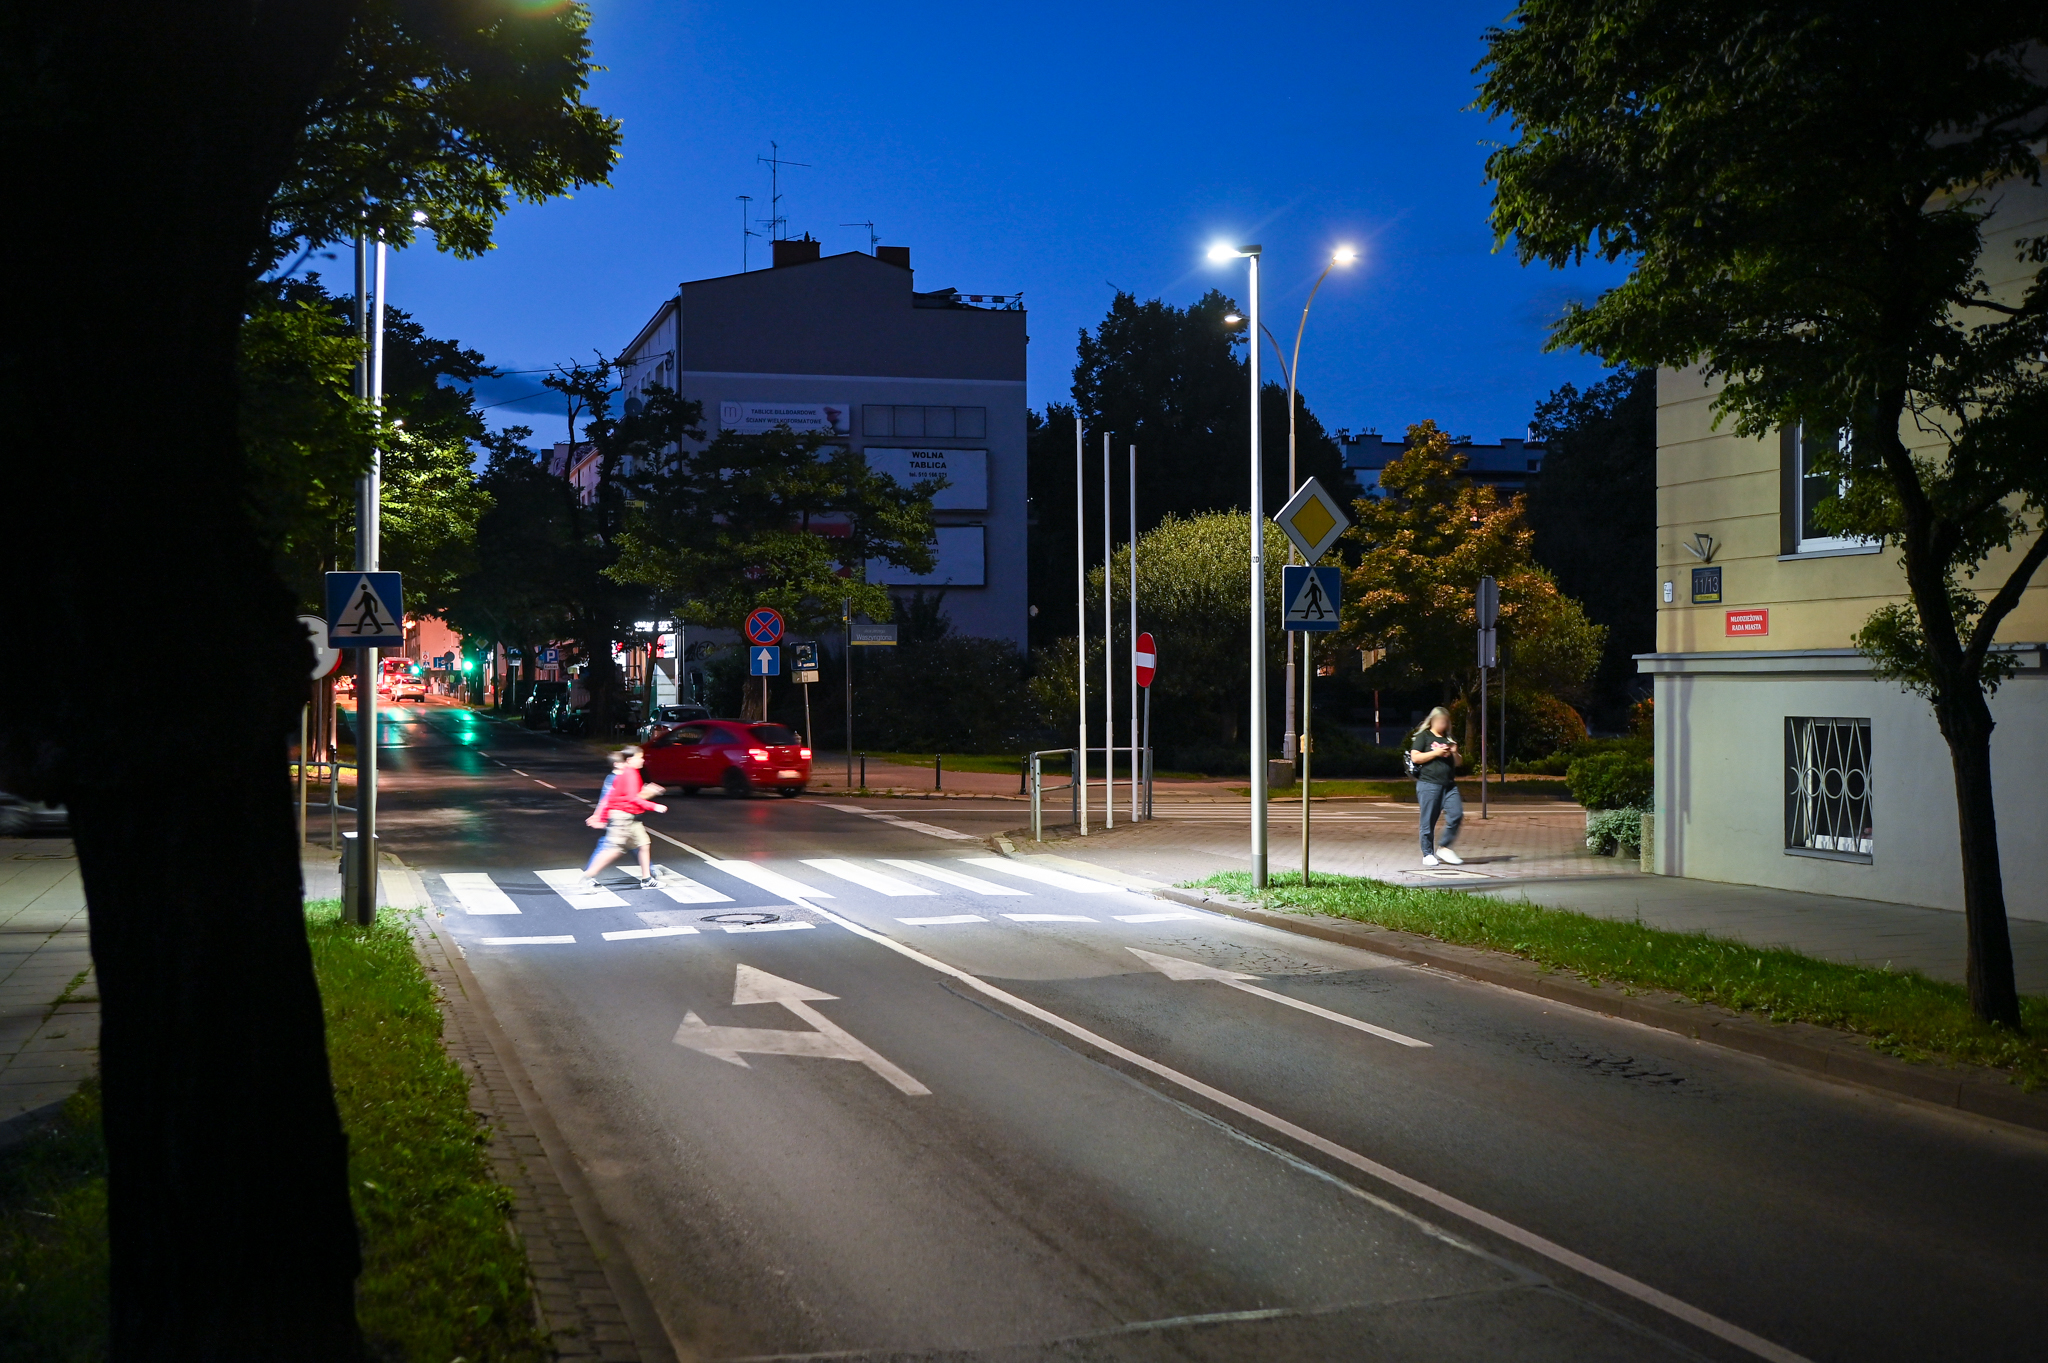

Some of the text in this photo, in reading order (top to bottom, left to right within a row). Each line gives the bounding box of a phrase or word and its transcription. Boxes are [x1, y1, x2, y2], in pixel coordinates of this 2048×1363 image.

[912, 451, 944, 459] WOLNA
[909, 461, 947, 469] TABLICA
[1694, 576, 1719, 594] 11/13
[1730, 614, 1763, 622] MŁODZIEŻOWA
[1745, 623, 1762, 631] MIASTA
[856, 634, 893, 642] Waszyngtona
